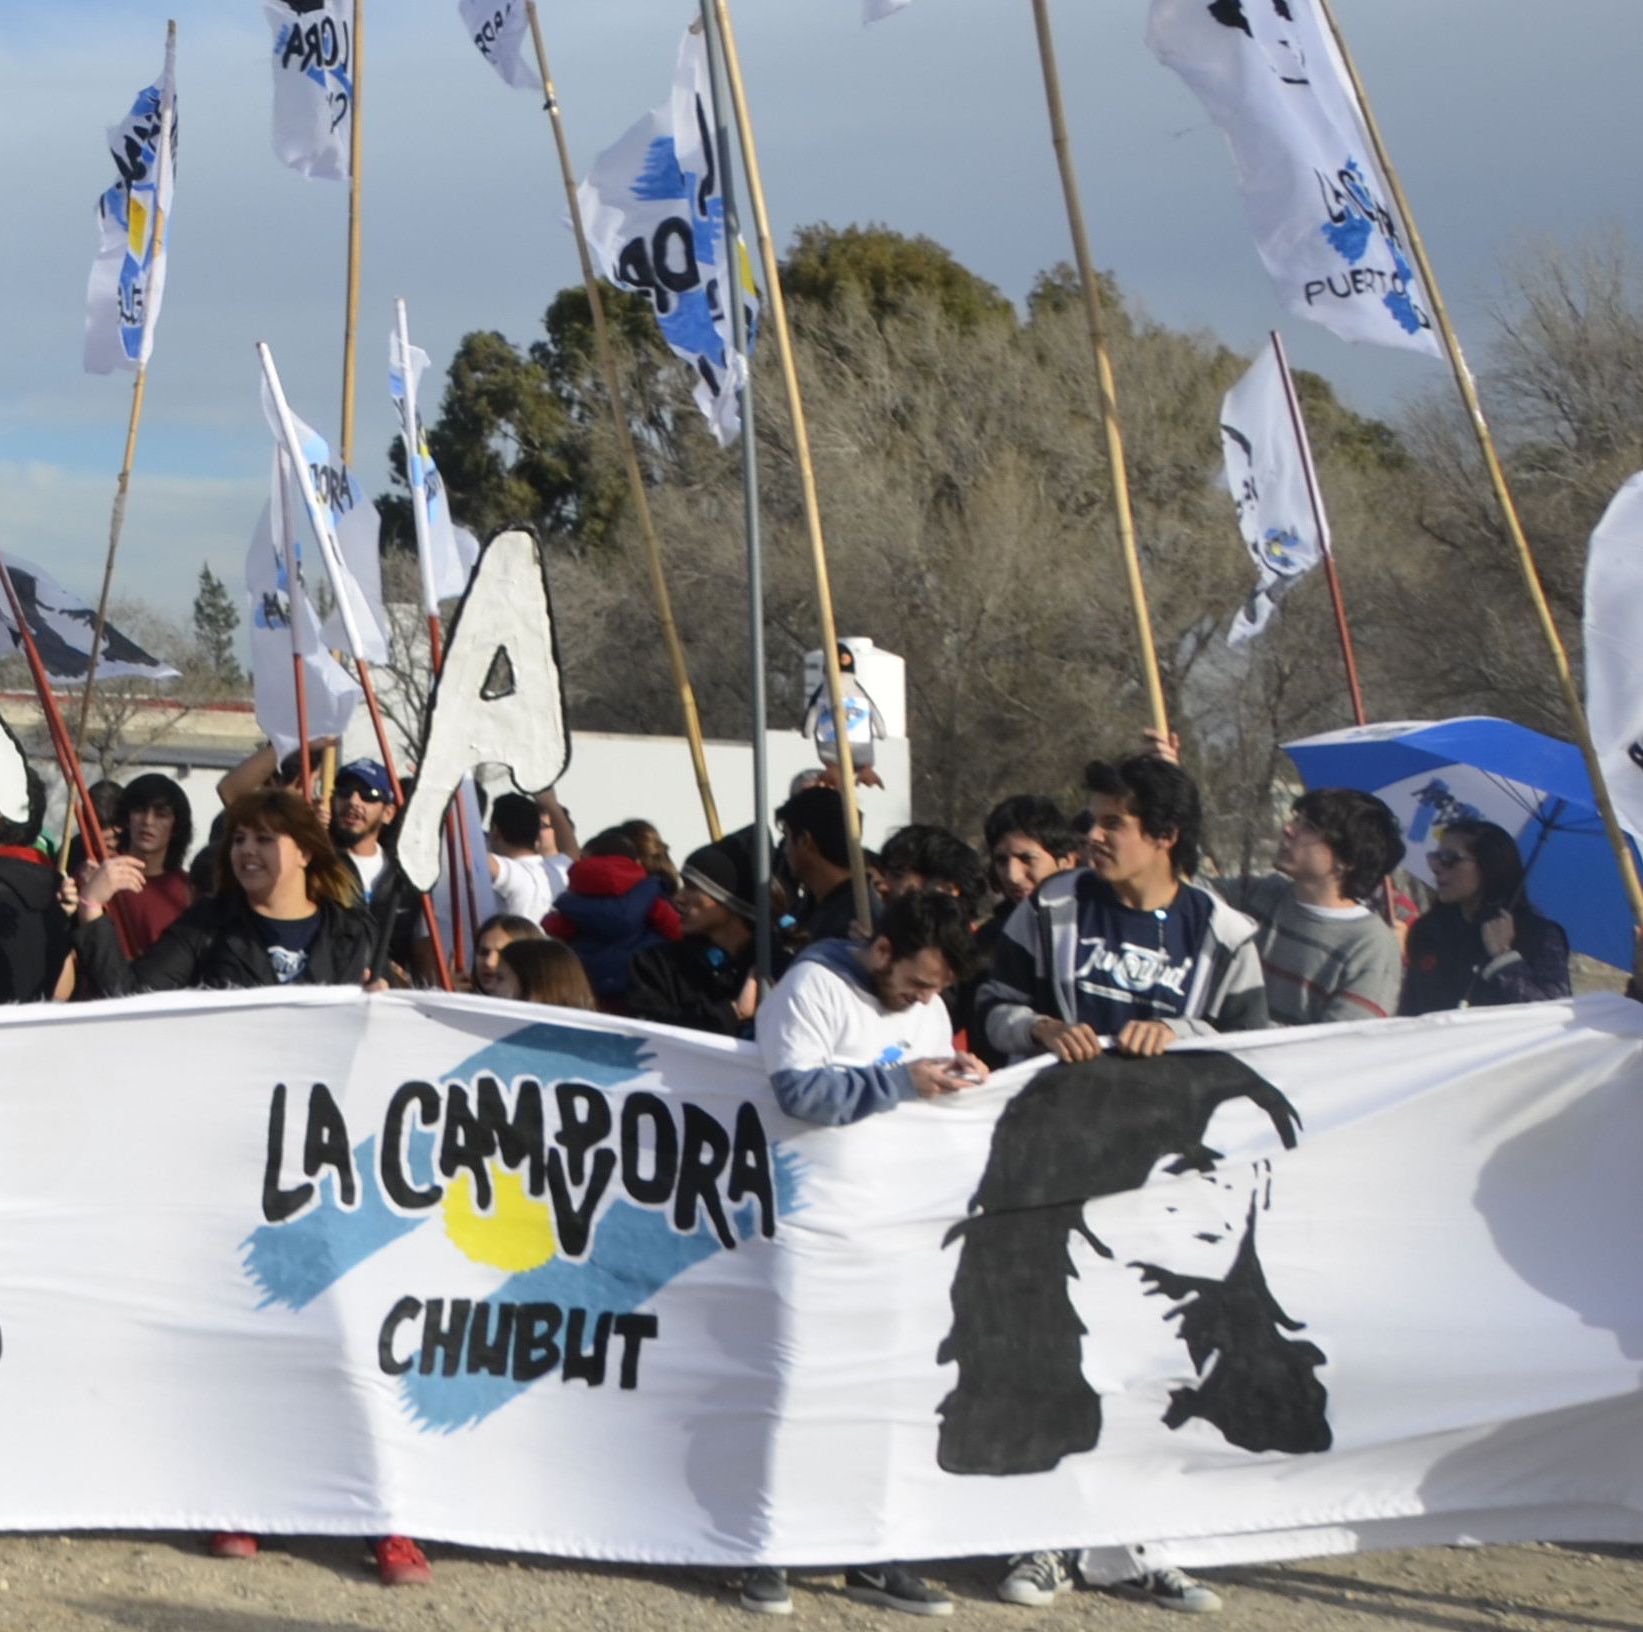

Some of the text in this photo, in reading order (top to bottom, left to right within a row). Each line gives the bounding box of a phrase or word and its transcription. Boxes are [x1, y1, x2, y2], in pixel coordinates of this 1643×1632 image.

[1304, 267, 1408, 306] PUERTO
[262, 1082, 354, 1222] LA
[379, 1296, 658, 1389] CHUBUT
